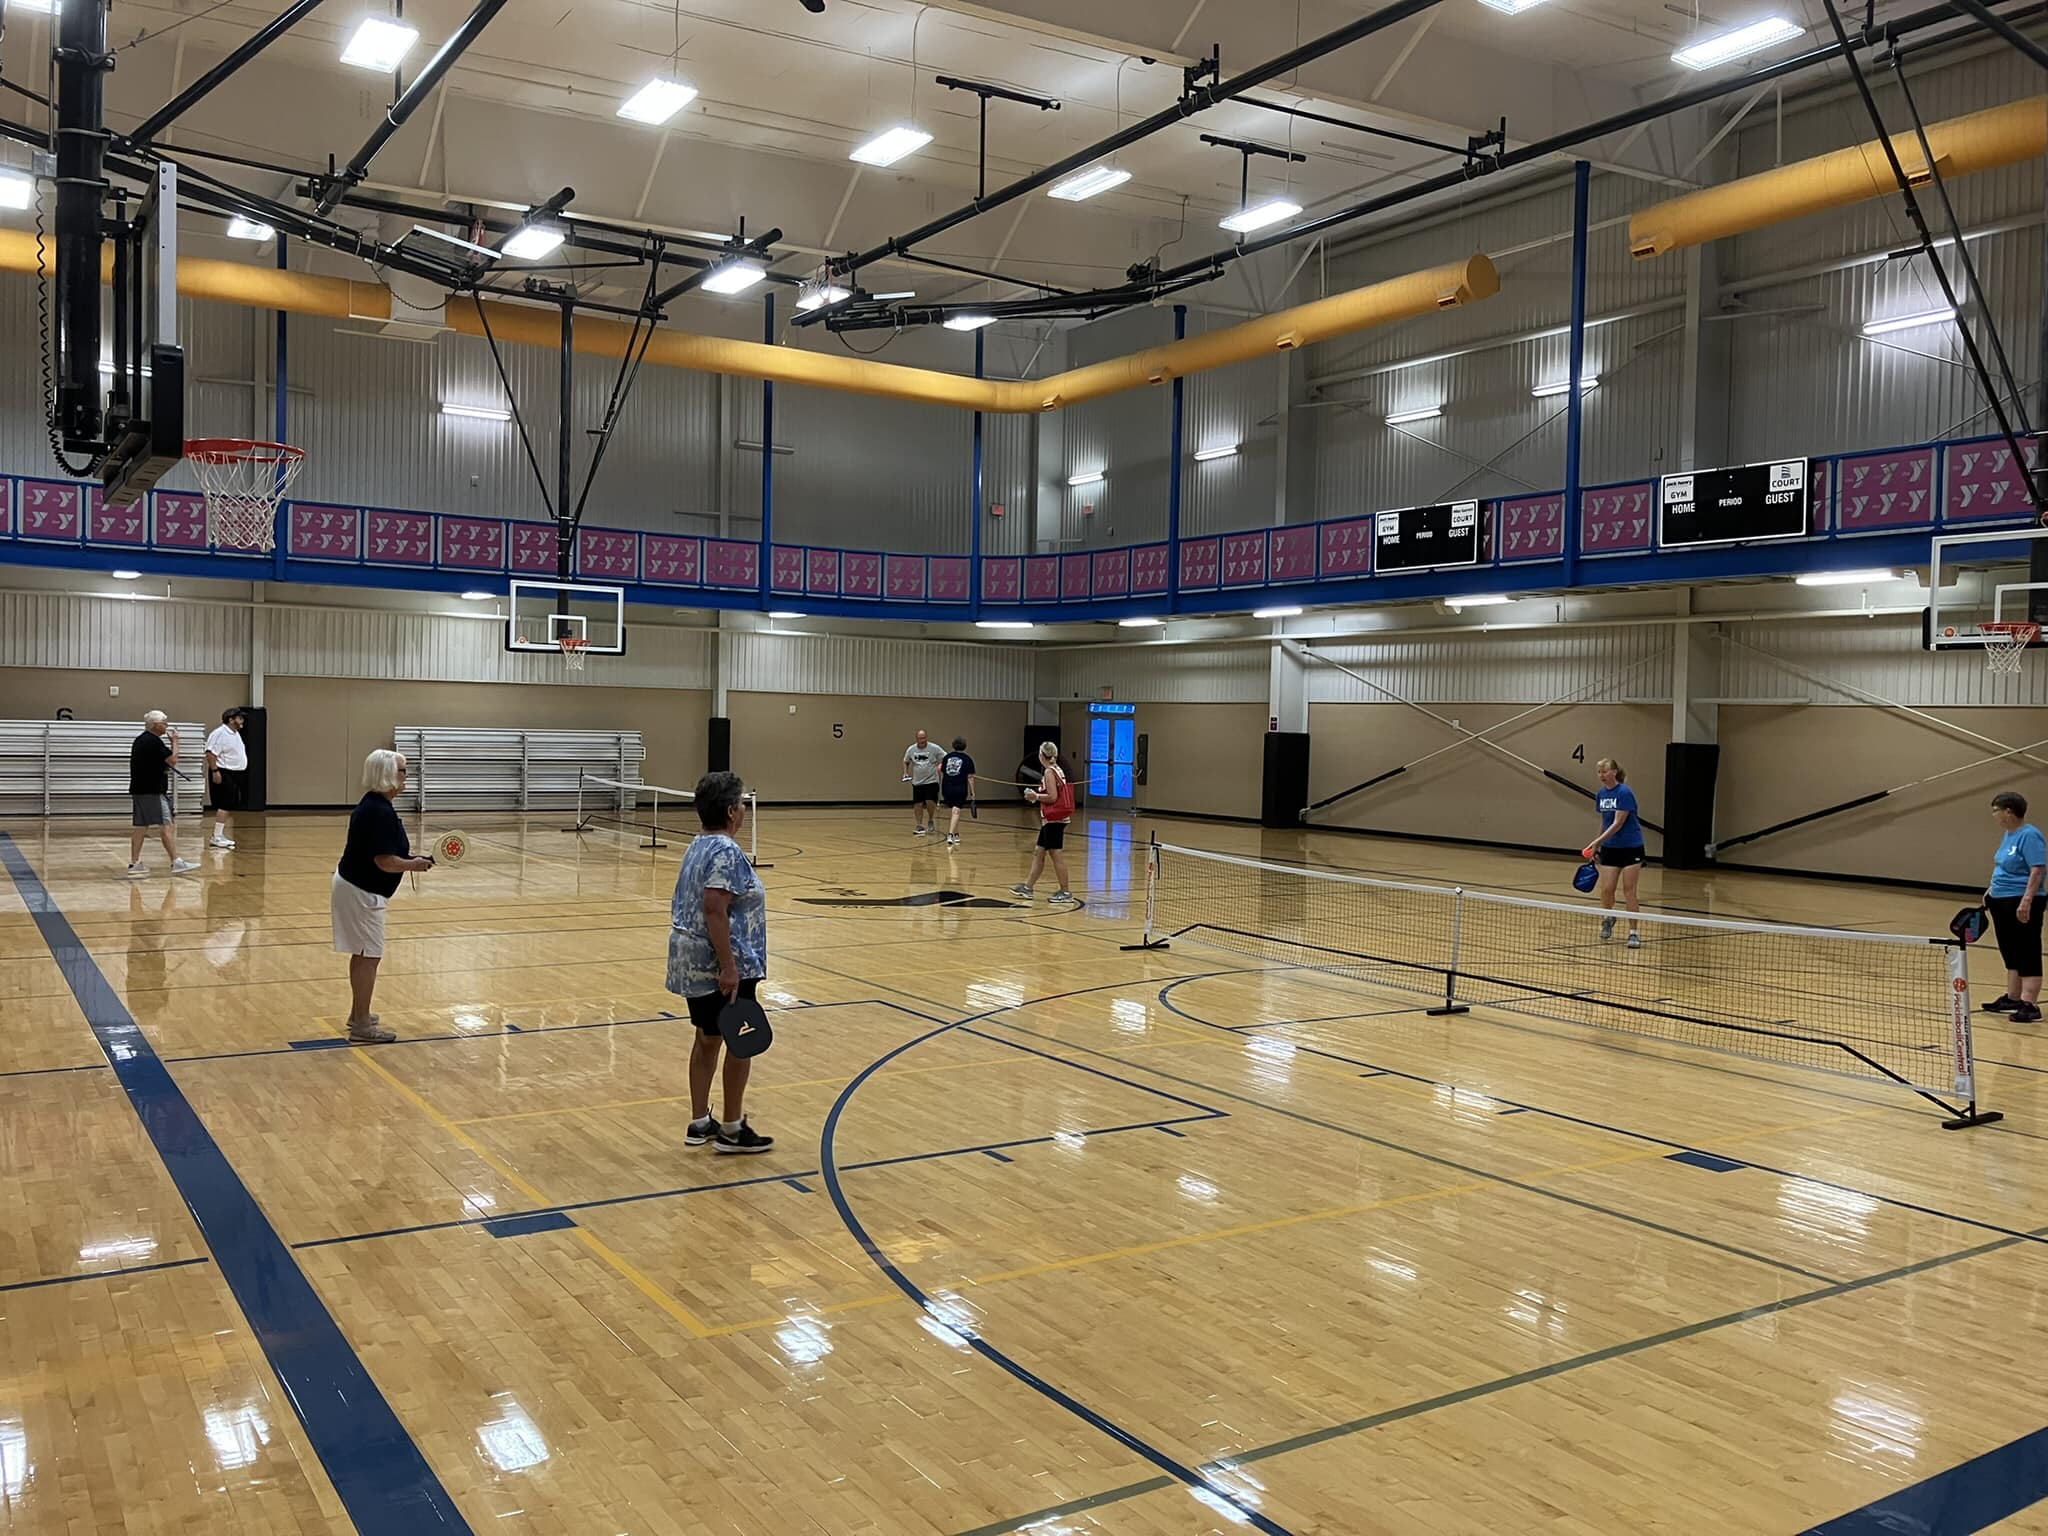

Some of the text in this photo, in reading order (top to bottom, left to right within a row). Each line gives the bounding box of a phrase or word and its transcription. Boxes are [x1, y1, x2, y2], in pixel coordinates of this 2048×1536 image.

[1772, 478, 1800, 489] COURT
[1670, 490, 1687, 500] GYM
[1766, 492, 1795, 505] GUEST
[1719, 497, 1743, 507] PERIOD
[1672, 503, 1696, 514] HOME
[1448, 527, 1470, 538] GUEST
[1383, 535, 1400, 545] HOME
[833, 723, 844, 739] 5
[1571, 743, 1585, 764] 4
